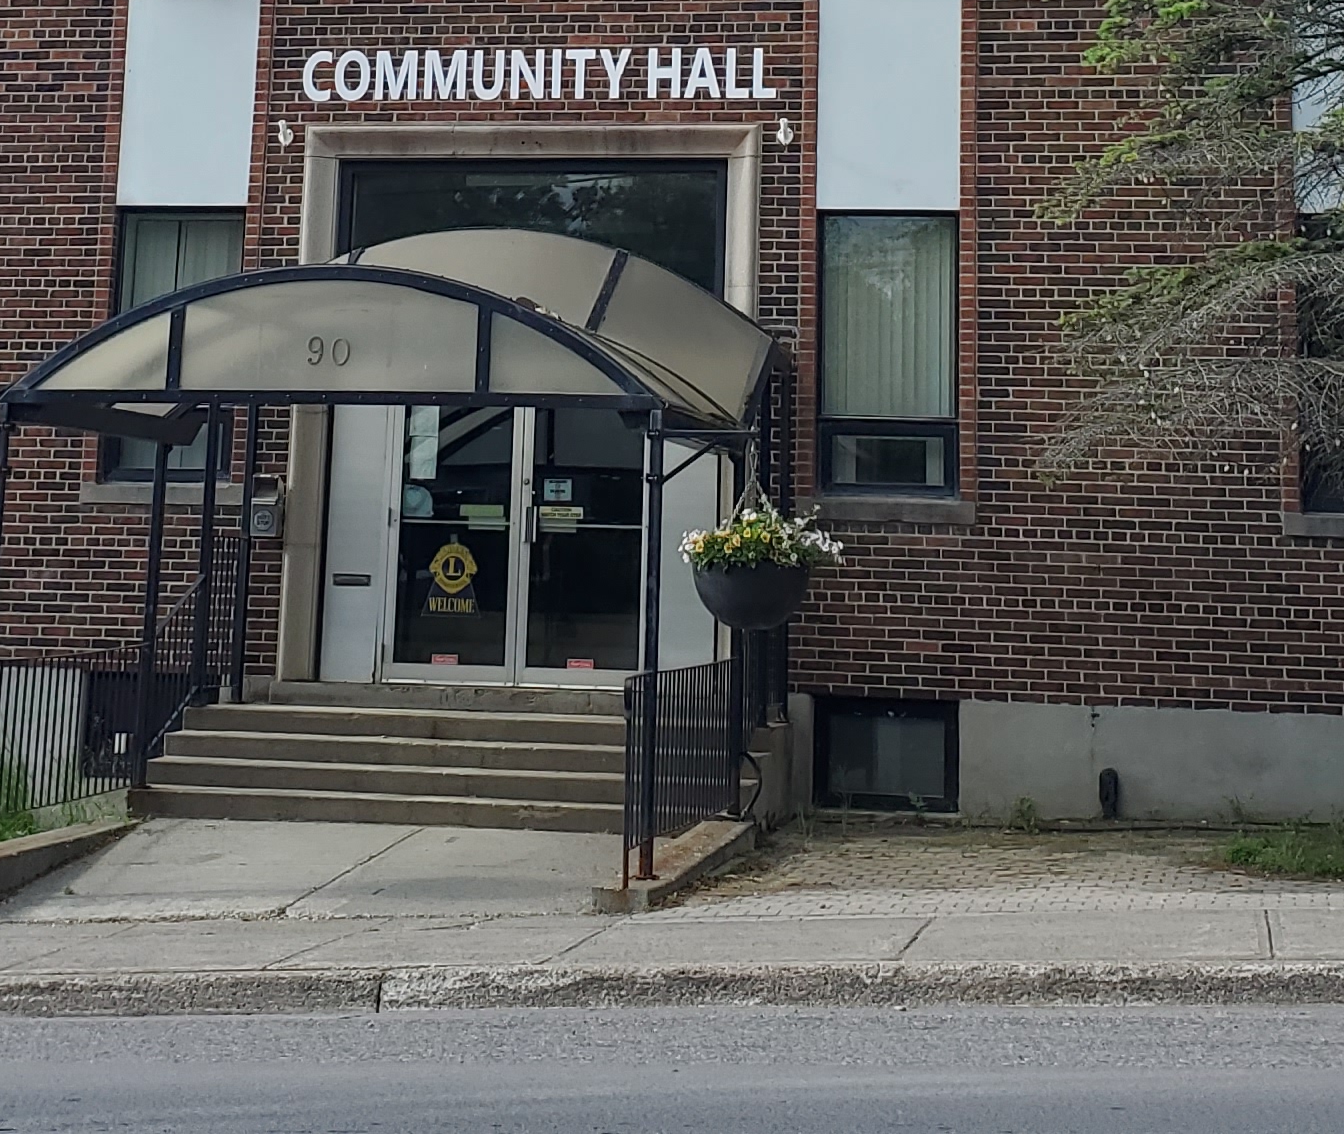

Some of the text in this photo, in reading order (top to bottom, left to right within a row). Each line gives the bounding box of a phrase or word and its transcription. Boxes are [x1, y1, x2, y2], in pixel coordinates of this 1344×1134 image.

[302, 47, 777, 101] COMMUNITY HALL
[307, 336, 350, 366] 90
[429, 597, 474, 613] WELCOME
